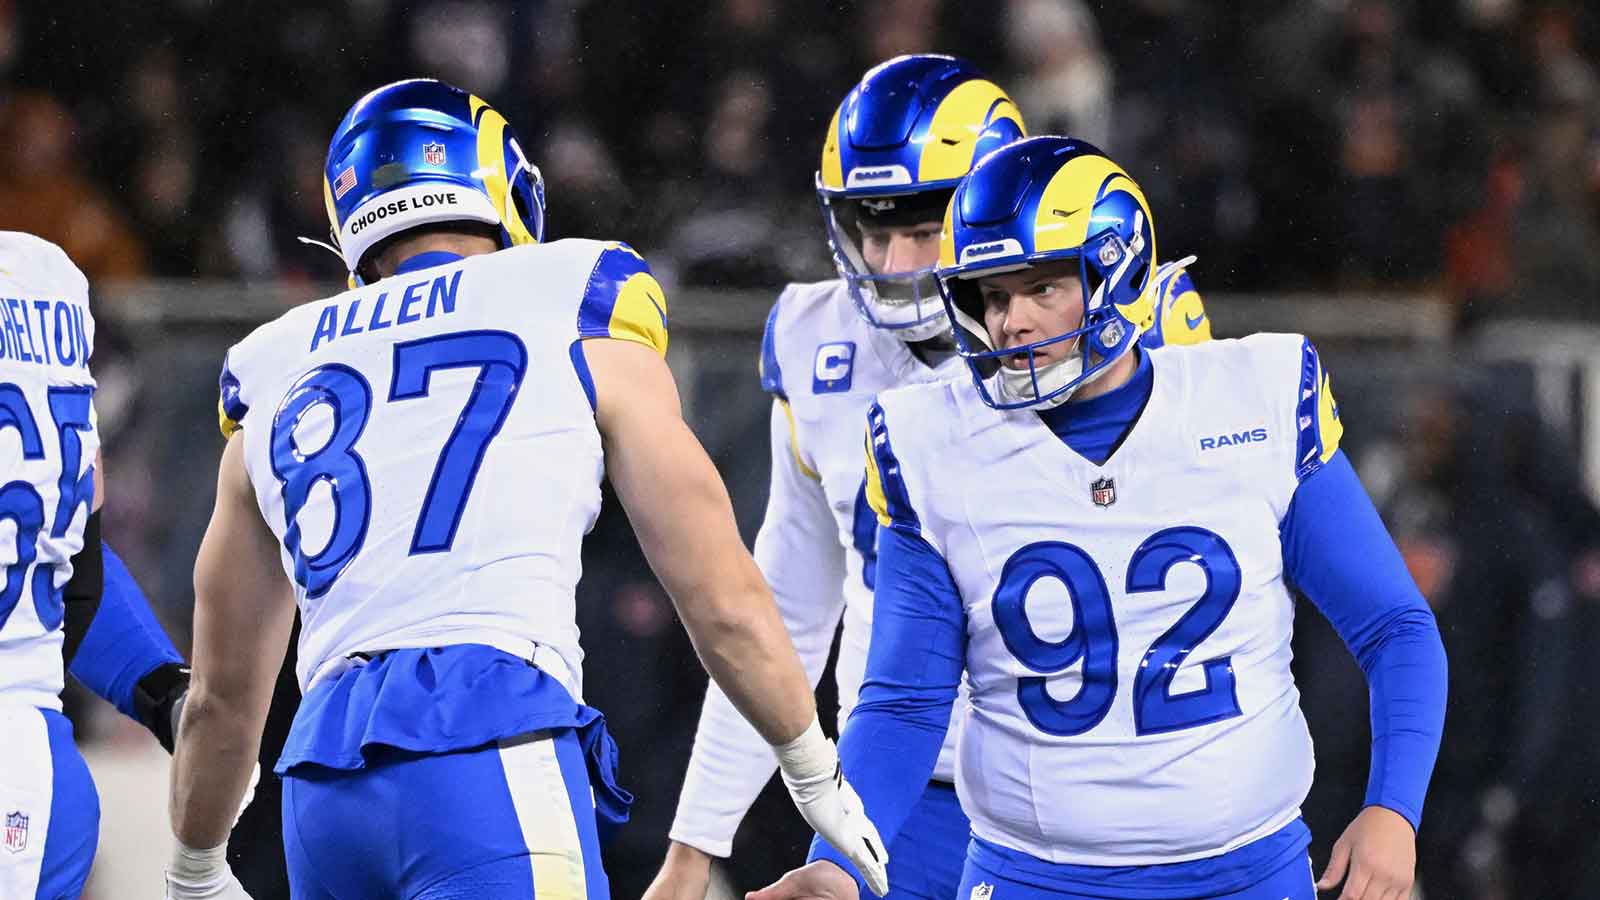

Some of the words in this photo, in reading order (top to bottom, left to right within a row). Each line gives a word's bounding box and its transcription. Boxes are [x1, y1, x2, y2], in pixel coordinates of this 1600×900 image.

[351, 200, 408, 234] CHOOSE
[412, 193, 457, 209] LOVE
[0, 298, 89, 368] HELTON
[310, 270, 464, 352] ALLEN
[816, 346, 849, 380] C
[270, 329, 528, 599] 87
[1200, 429, 1267, 450] RAMS
[991, 526, 1242, 737] 92
[6, 829, 24, 848] NFL
